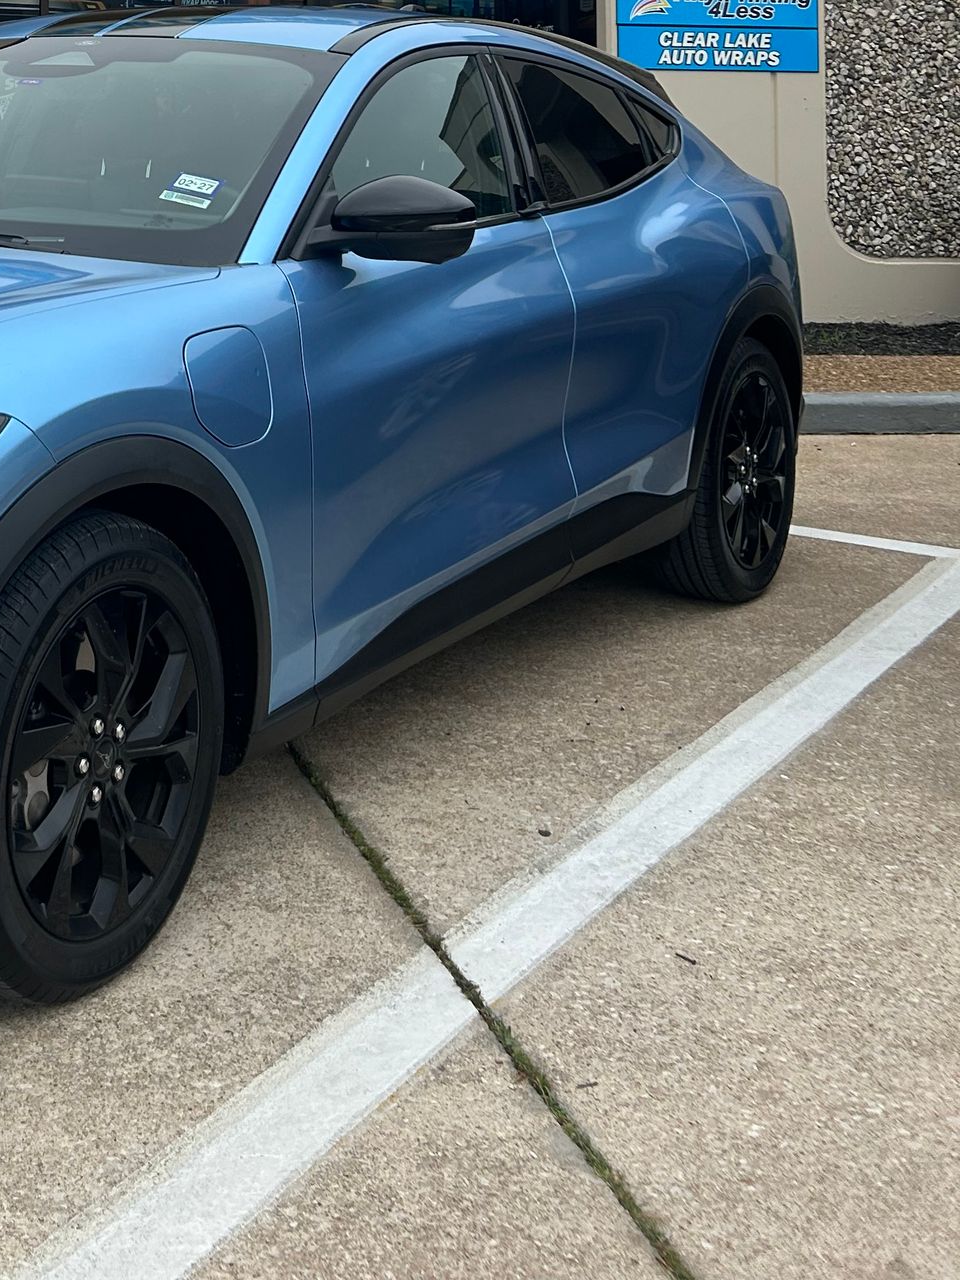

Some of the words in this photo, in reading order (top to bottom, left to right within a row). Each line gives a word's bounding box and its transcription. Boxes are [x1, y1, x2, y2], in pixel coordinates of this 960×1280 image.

[707, 1, 775, 19] 4Less
[659, 31, 719, 48] CLEAR
[724, 33, 772, 49] LAKE
[658, 49, 708, 65] AUTO
[714, 50, 781, 66] WRAPS
